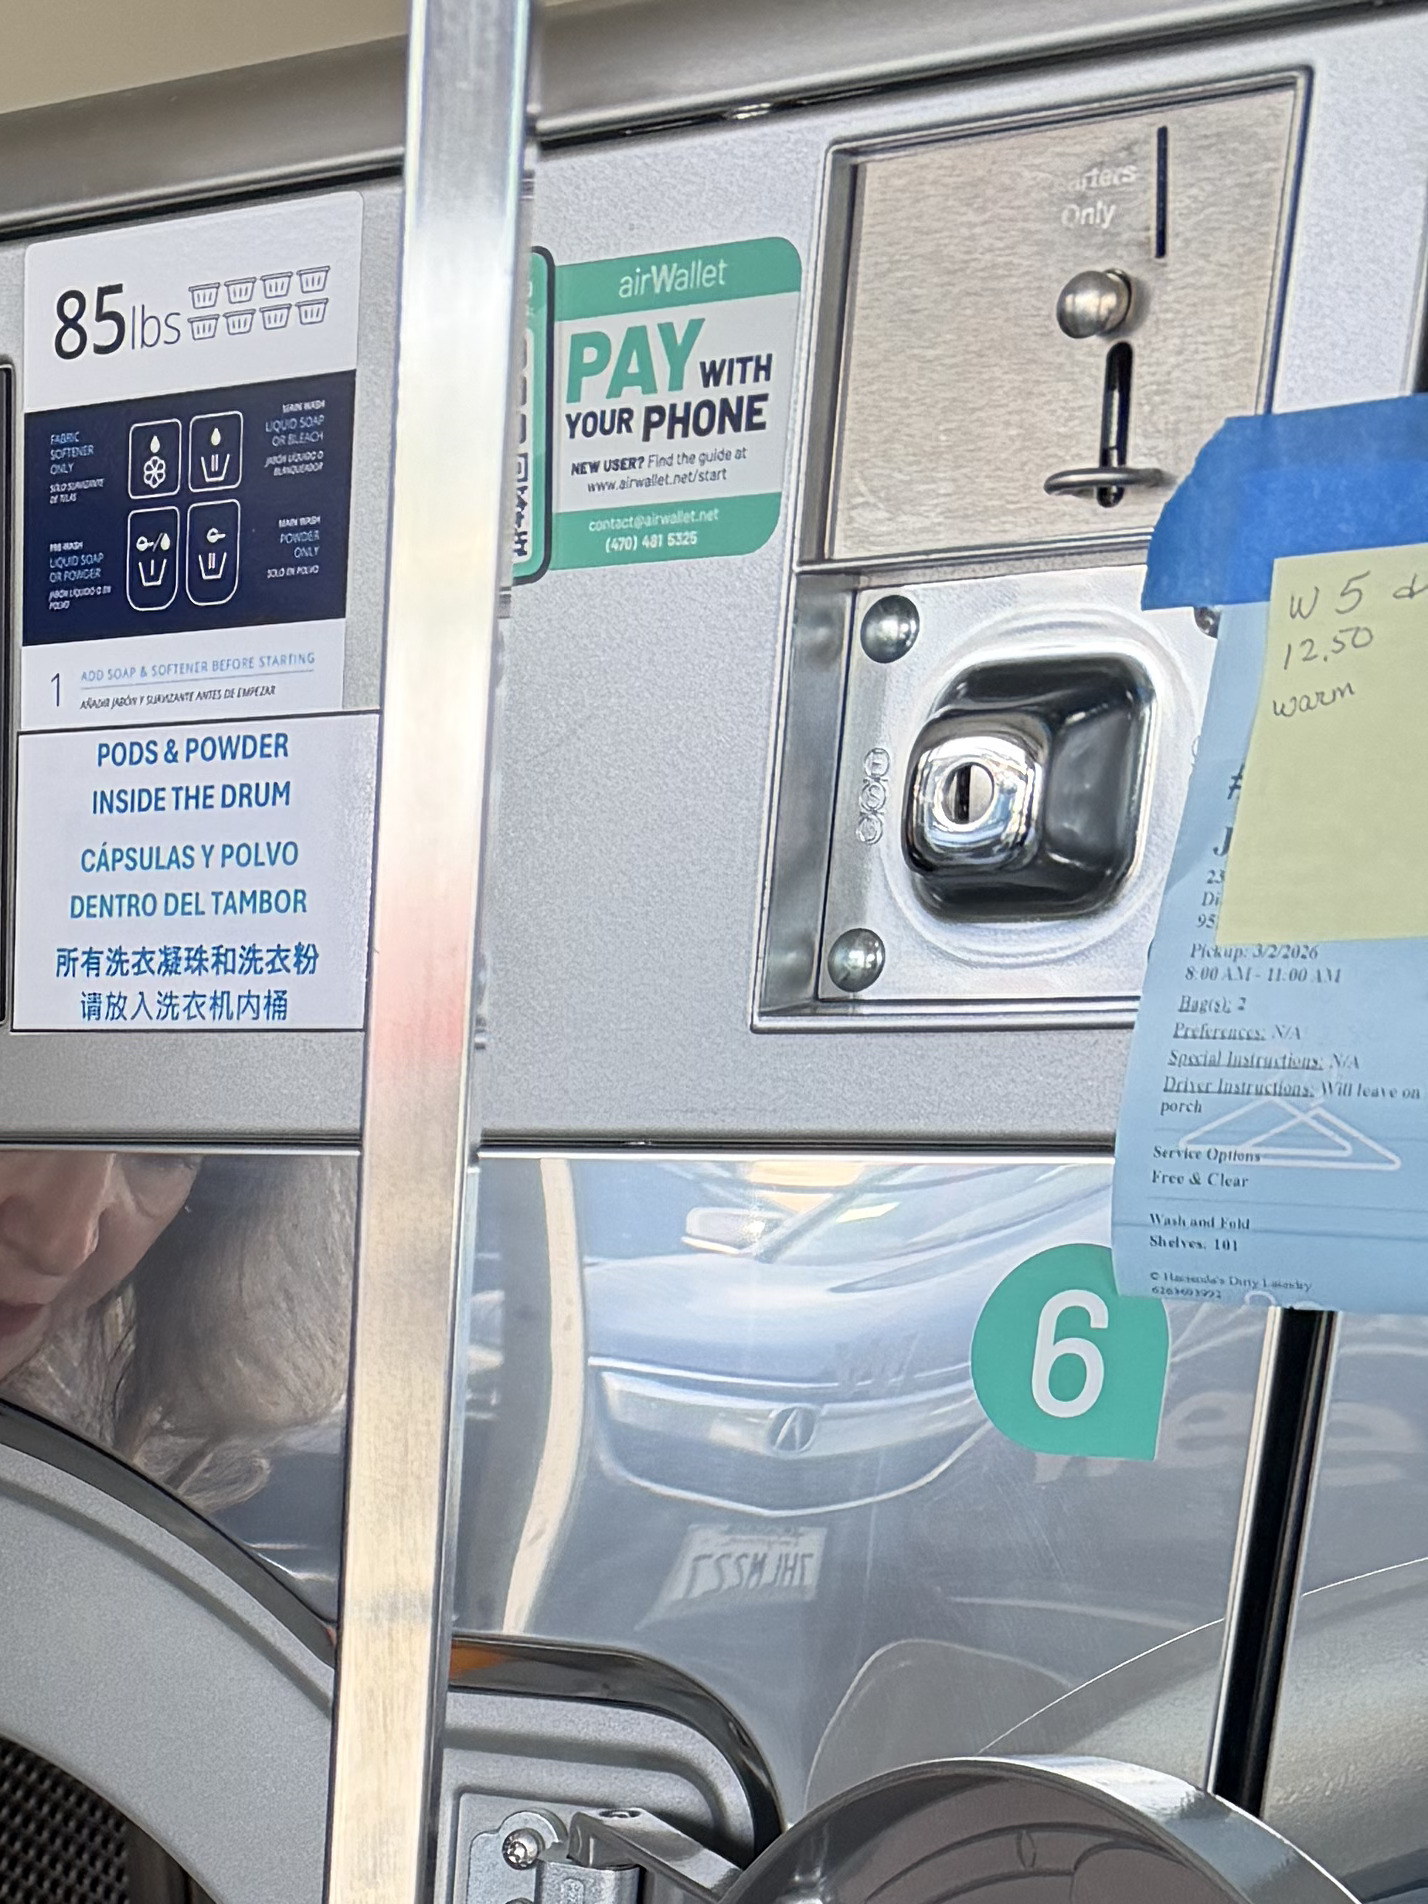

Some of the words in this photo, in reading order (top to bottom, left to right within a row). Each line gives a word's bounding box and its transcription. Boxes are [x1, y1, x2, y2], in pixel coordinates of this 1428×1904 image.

[1060, 200, 1117, 229] Only
[618, 258, 729, 299] airWallet
[565, 317, 706, 404] PAY
[699, 352, 773, 389] WITH
[265, 417, 298, 433] LIQUID
[299, 414, 325, 428] SOAP
[565, 407, 635, 439] YOUR
[641, 392, 770, 443] PHONE
[50, 431, 80, 445] FABRIC
[271, 434, 286, 447] OR
[287, 431, 324, 445] BLEACH
[50, 444, 94, 460] SOFTENER
[571, 460, 600, 476] NEW
[603, 455, 645, 472] USER?
[647, 453, 674, 469] Find
[676, 451, 696, 466] the
[698, 448, 732, 466] guide
[734, 446, 748, 460] at
[49, 462, 75, 475] ONLY
[587, 467, 728, 493] www.airwallet.net/start
[588, 507, 720, 533] contact@airwallet.net
[280, 529, 320, 543] POWDER
[604, 534, 638, 553] (470)
[641, 533, 663, 549] 481
[49, 555, 79, 569] LIQUID
[80, 552, 104, 566] SOAP
[293, 546, 320, 558] ONLY
[49, 571, 62, 583] OR
[63, 567, 102, 581] POWDER
[1335, 569, 1371, 615] 5
[1283, 625, 1374, 671] 12.50
[80, 670, 104, 682] ADD
[107, 668, 136, 681] SOAP
[140, 666, 148, 678] &
[151, 660, 208, 677] SOFTENER
[211, 657, 255, 672] BEFORE
[259, 652, 316, 669] STARTING
[50, 672, 60, 707] 1
[139, 695, 145, 705] Y
[195, 689, 221, 701] ANTES
[223, 687, 235, 699] DE
[236, 685, 276, 698] EMPEZAR
[1272, 682, 1356, 718] warm
[97, 739, 158, 767] PODS
[163, 738, 178, 763] &
[185, 732, 289, 764] POWDER
[92, 786, 166, 815] INSIDE
[171, 784, 215, 811] THE
[221, 780, 291, 809] DRUM
[80, 841, 195, 873] CÁPSULAS
[200, 844, 215, 869] Y
[221, 840, 299, 868] POLVO
[70, 892, 158, 919] DENTRO
[163, 890, 205, 917] DEL
[211, 888, 307, 914] TAMBOR
[55, 941, 320, 979] 所有洗衣凝珠和洗衣粉
[1190, 943, 1248, 963] Pickup:
[1252, 943, 1319, 960] 3/2/2026
[1185, 965, 1219, 981] 8:00
[1221, 965, 1252, 982] AM
[1267, 967, 1308, 983] 11:00
[1311, 967, 1342, 984] AM
[79, 988, 289, 1022] 请放入洗衣机内桶
[1172, 1021, 1267, 1041] Preferences:
[1272, 1023, 1301, 1040] N/A
[1167, 1049, 1222, 1068] Special
[1227, 1050, 1324, 1071] Instructions:
[1329, 1052, 1360, 1070] N/A
[1163, 1075, 1212, 1094] Driver
[1217, 1077, 1316, 1098] Instructions:
[1321, 1080, 1352, 1098] Will
[1356, 1082, 1398, 1098] leave
[1402, 1088, 1421, 1100] on
[1160, 1099, 1203, 1116] porch
[1153, 1145, 1203, 1160] Service
[1206, 1147, 1262, 1164] Options
[1151, 1169, 1185, 1185] Free
[1189, 1171, 1202, 1186] &
[1207, 1171, 1249, 1188] Clear
[1149, 1213, 1186, 1228] Wash
[1190, 1216, 1215, 1229] and
[1220, 1216, 1250, 1230] Fold
[1215, 1238, 1238, 1252] 101
[1229, 1275, 1259, 1290] Dirty
[1031, 1288, 1110, 1419] 6
